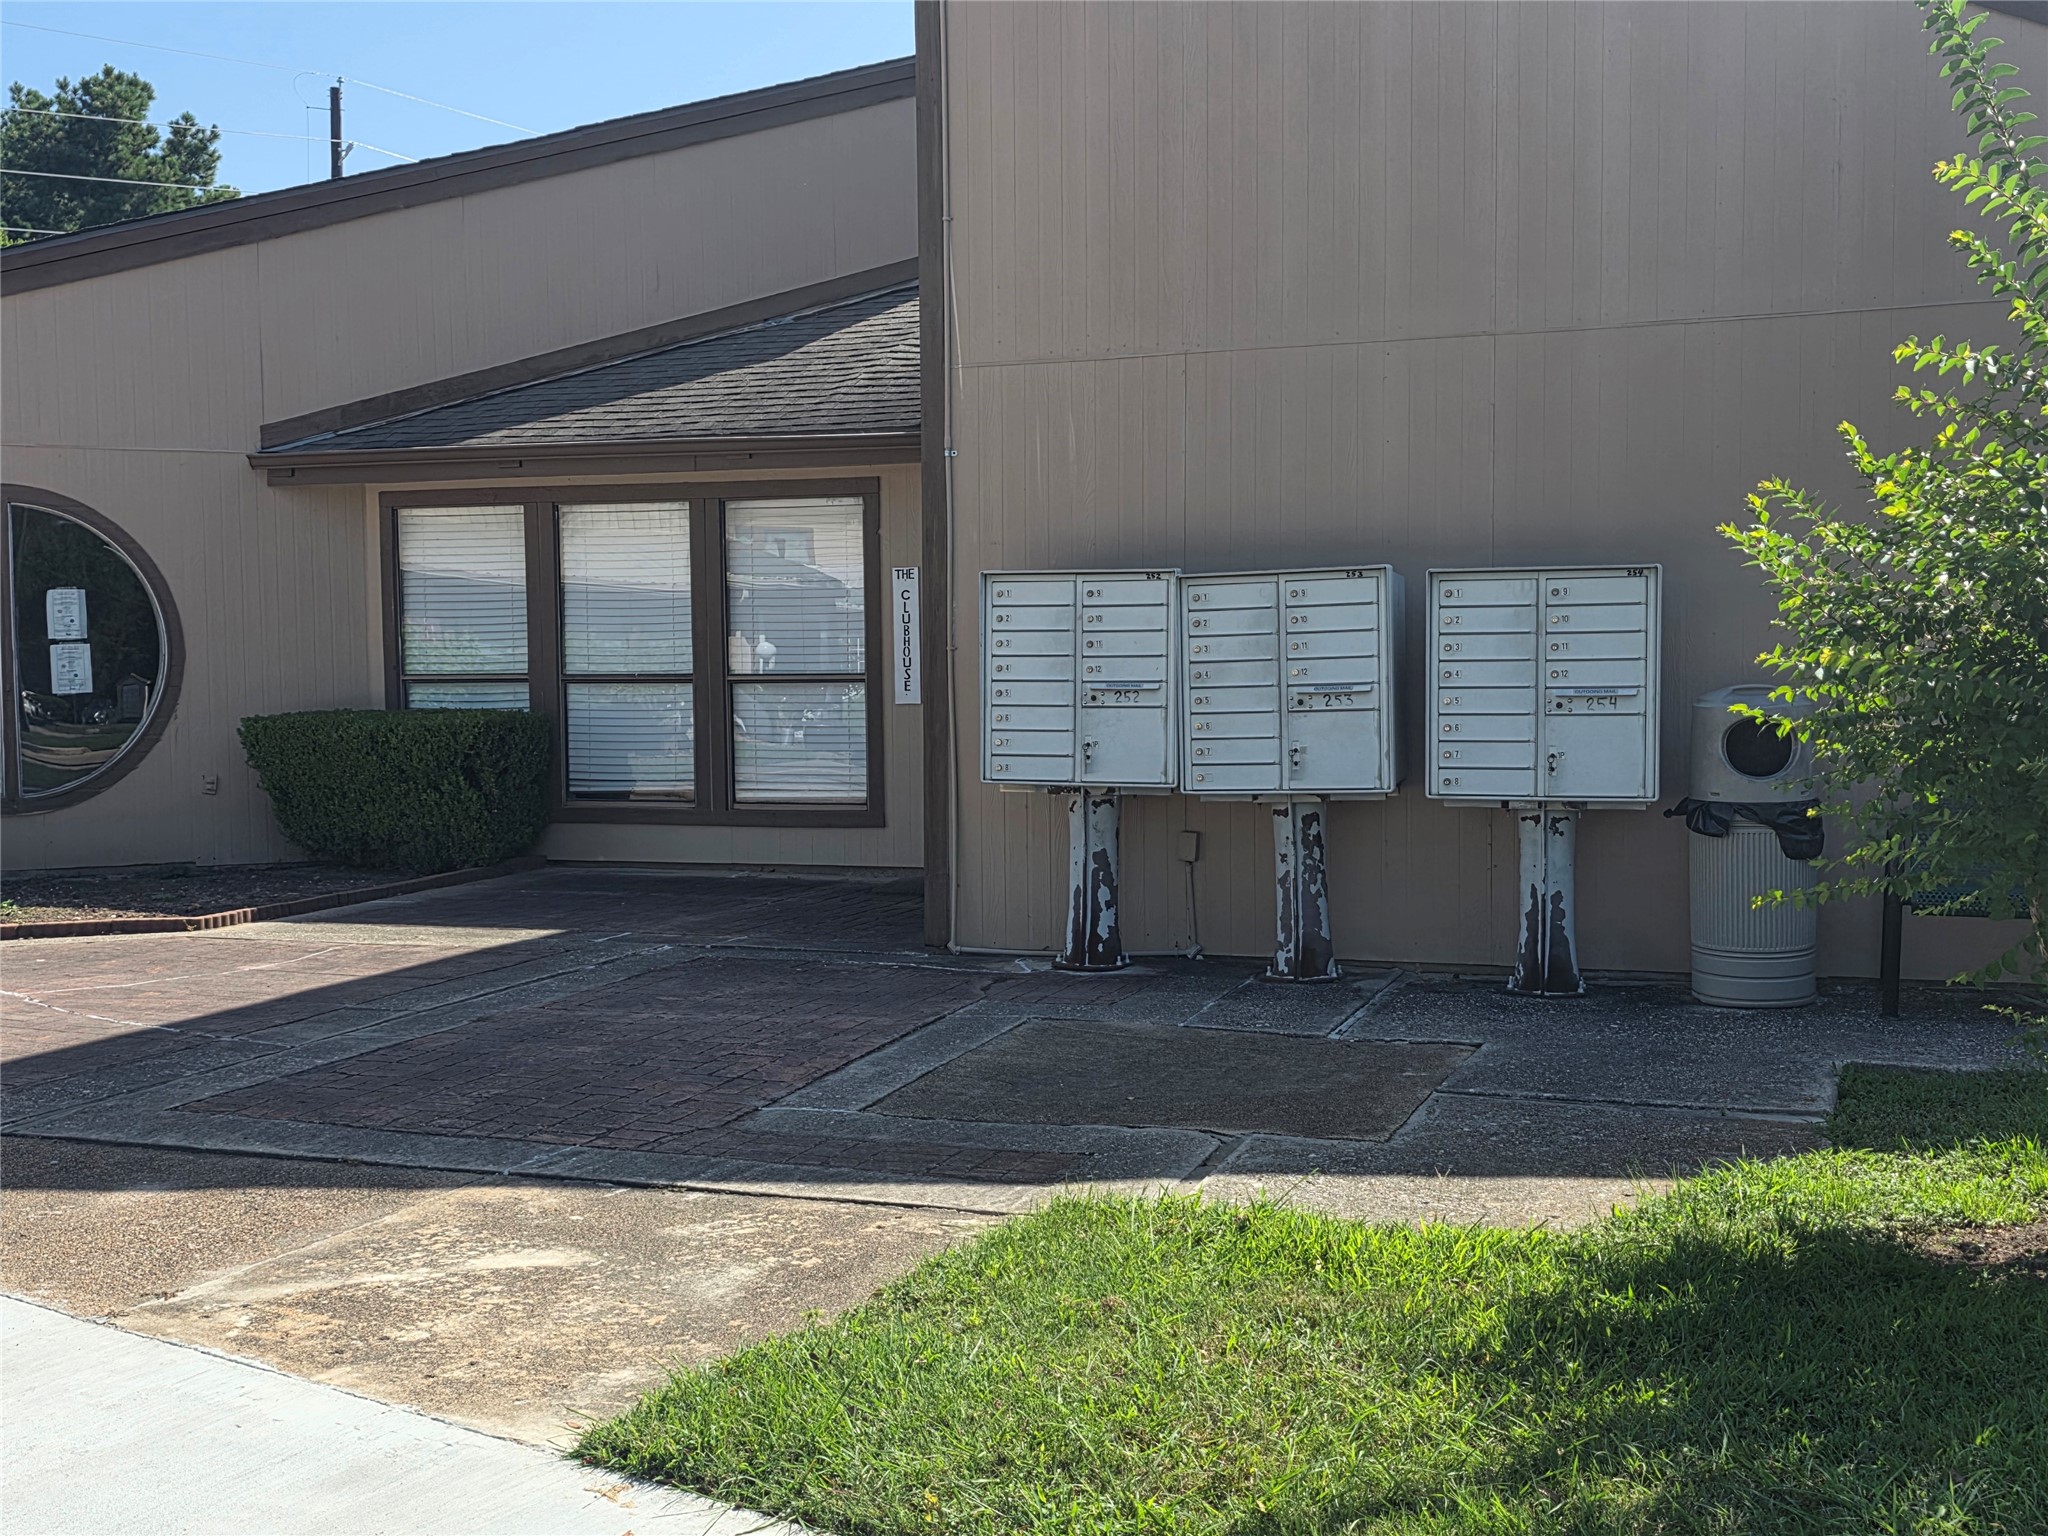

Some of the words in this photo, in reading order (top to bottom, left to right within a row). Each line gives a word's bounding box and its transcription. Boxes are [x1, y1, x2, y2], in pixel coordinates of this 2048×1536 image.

[894, 568, 915, 580] THE
[901, 590, 911, 691] CLUBHOUSE
[1114, 691, 1140, 703] 252
[1323, 694, 1353, 707] 253
[1586, 697, 1617, 710] 254
